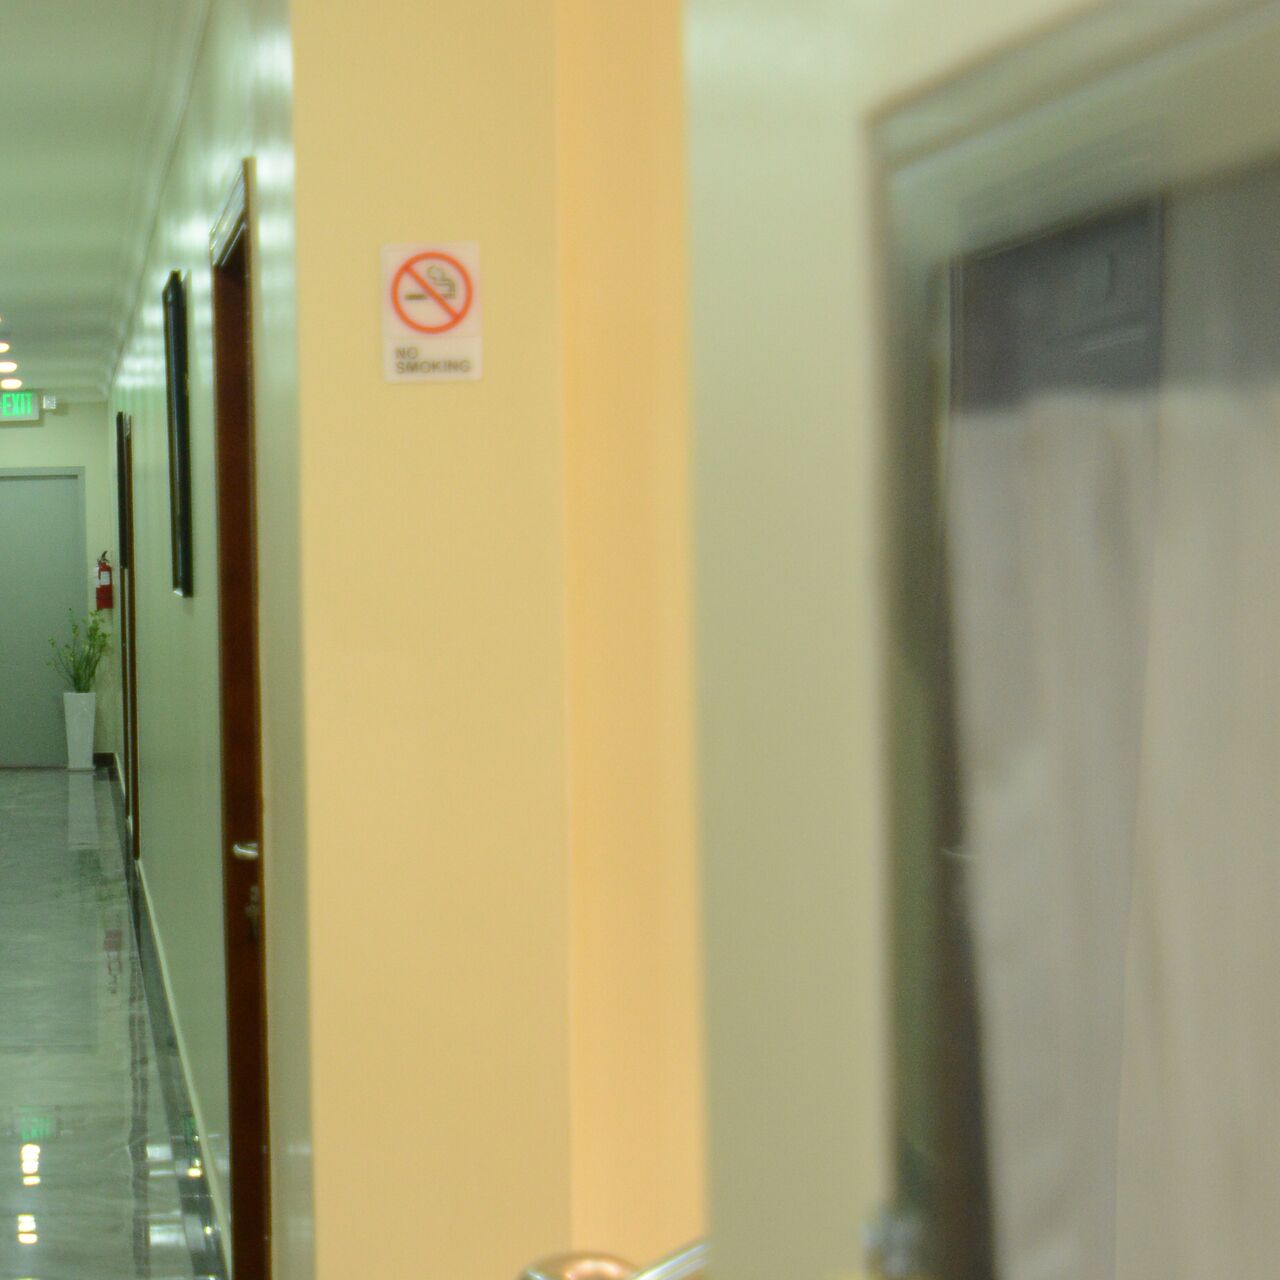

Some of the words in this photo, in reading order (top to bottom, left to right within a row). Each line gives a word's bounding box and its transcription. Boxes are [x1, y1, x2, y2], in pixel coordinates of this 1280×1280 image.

[395, 346, 419, 359] NO
[396, 359, 471, 374] SMOKING
[2, 392, 32, 416] EXIT
